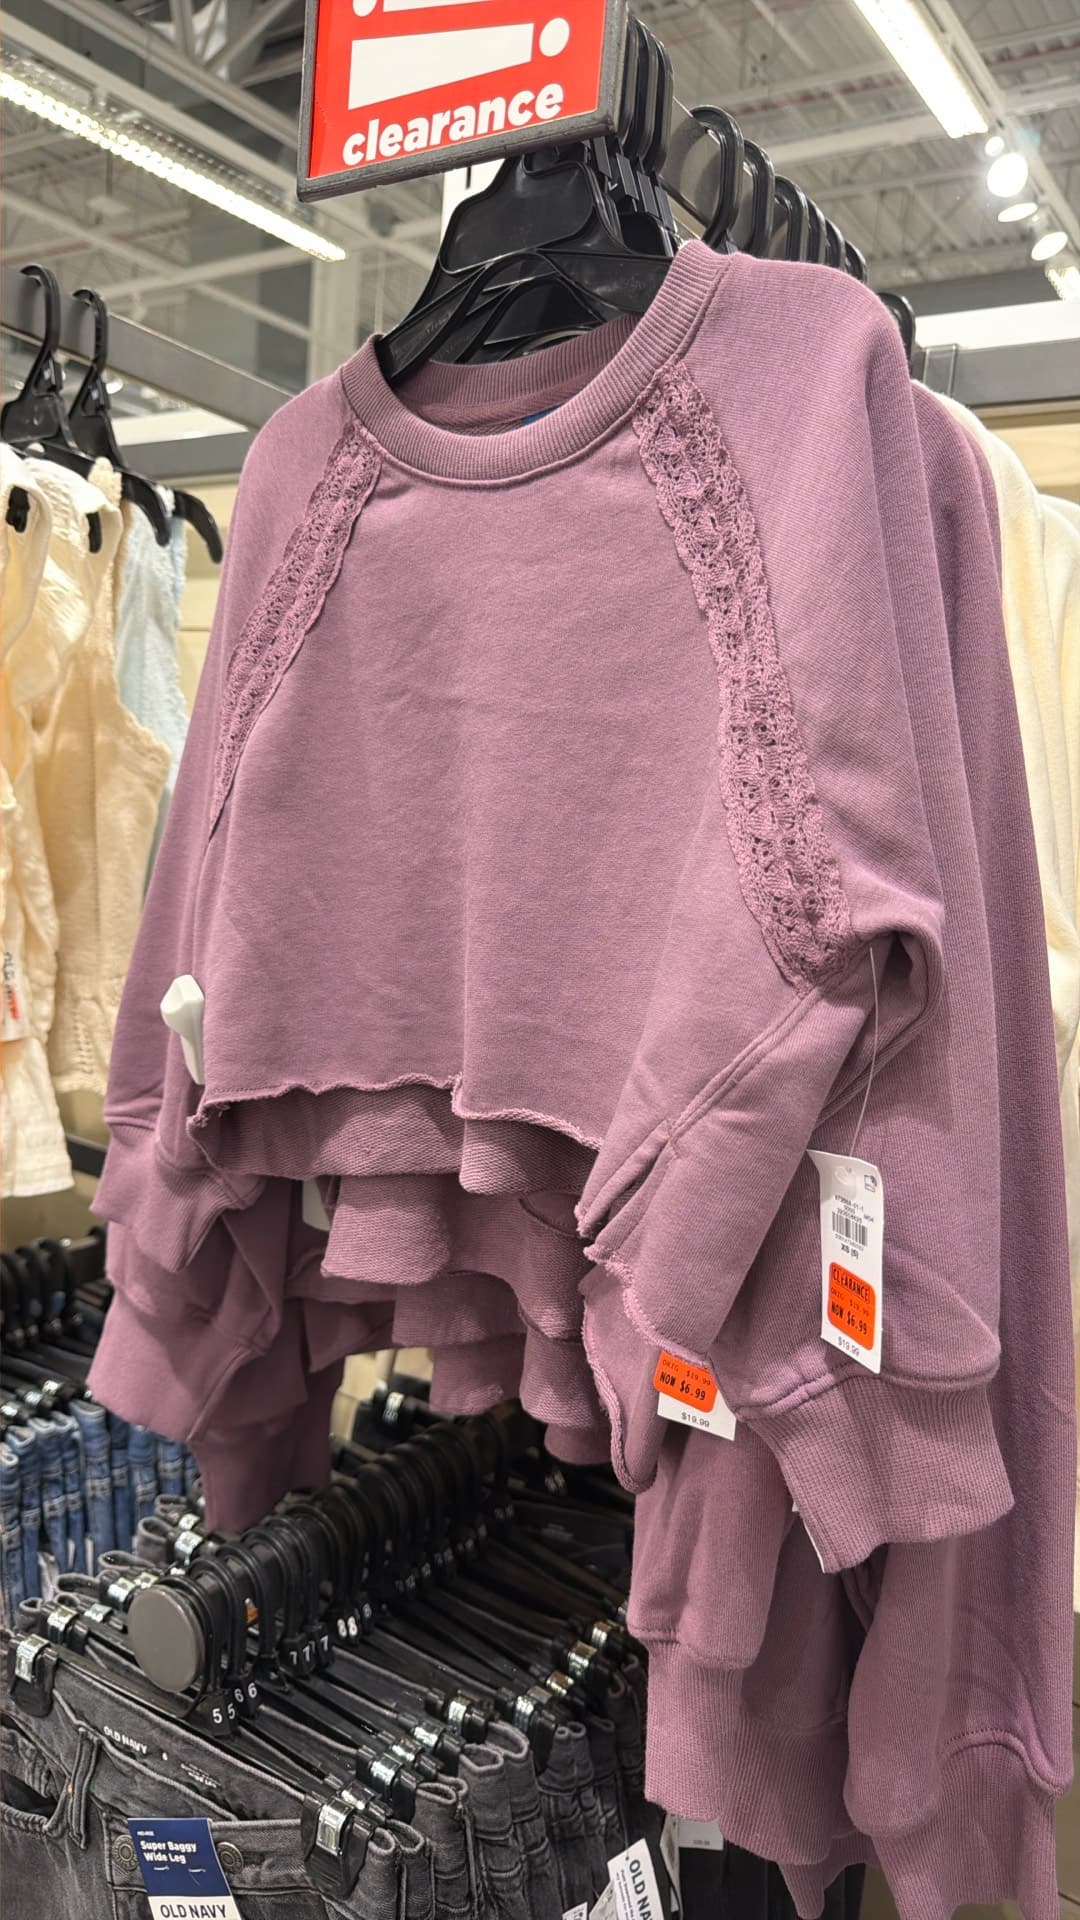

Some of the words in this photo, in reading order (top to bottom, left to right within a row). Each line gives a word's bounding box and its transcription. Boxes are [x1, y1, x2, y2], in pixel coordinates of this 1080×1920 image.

[342, 83, 564, 166] clearance
[832, 1268, 870, 1303] CLEARANCE
[831, 1301, 844, 1319] NOW
[847, 1311, 867, 1335] $6.99
[838, 1336, 860, 1357] $19.99
[659, 1372, 676, 1387] NOW
[679, 1380, 706, 1401] $6.99
[681, 1412, 710, 1428] $19.99
[320, 1635, 329, 1652] 7
[290, 1651, 298, 1665] 7
[234, 1688, 244, 1702] 6
[248, 1682, 257, 1698] 6
[212, 1708, 222, 1724] 5
[227, 1703, 236, 1719] 5
[103, 1725, 121, 1742] OLD
[121, 1734, 148, 1755] NAVY
[140, 1840, 166, 1852] Super
[167, 1841, 197, 1853] Baggy
[143, 1852, 168, 1862] Wide
[168, 1853, 187, 1864] Leg
[629, 1859, 646, 1895] OLD
[160, 1904, 187, 1919] OLD
[188, 1904, 227, 1919] NAVY
